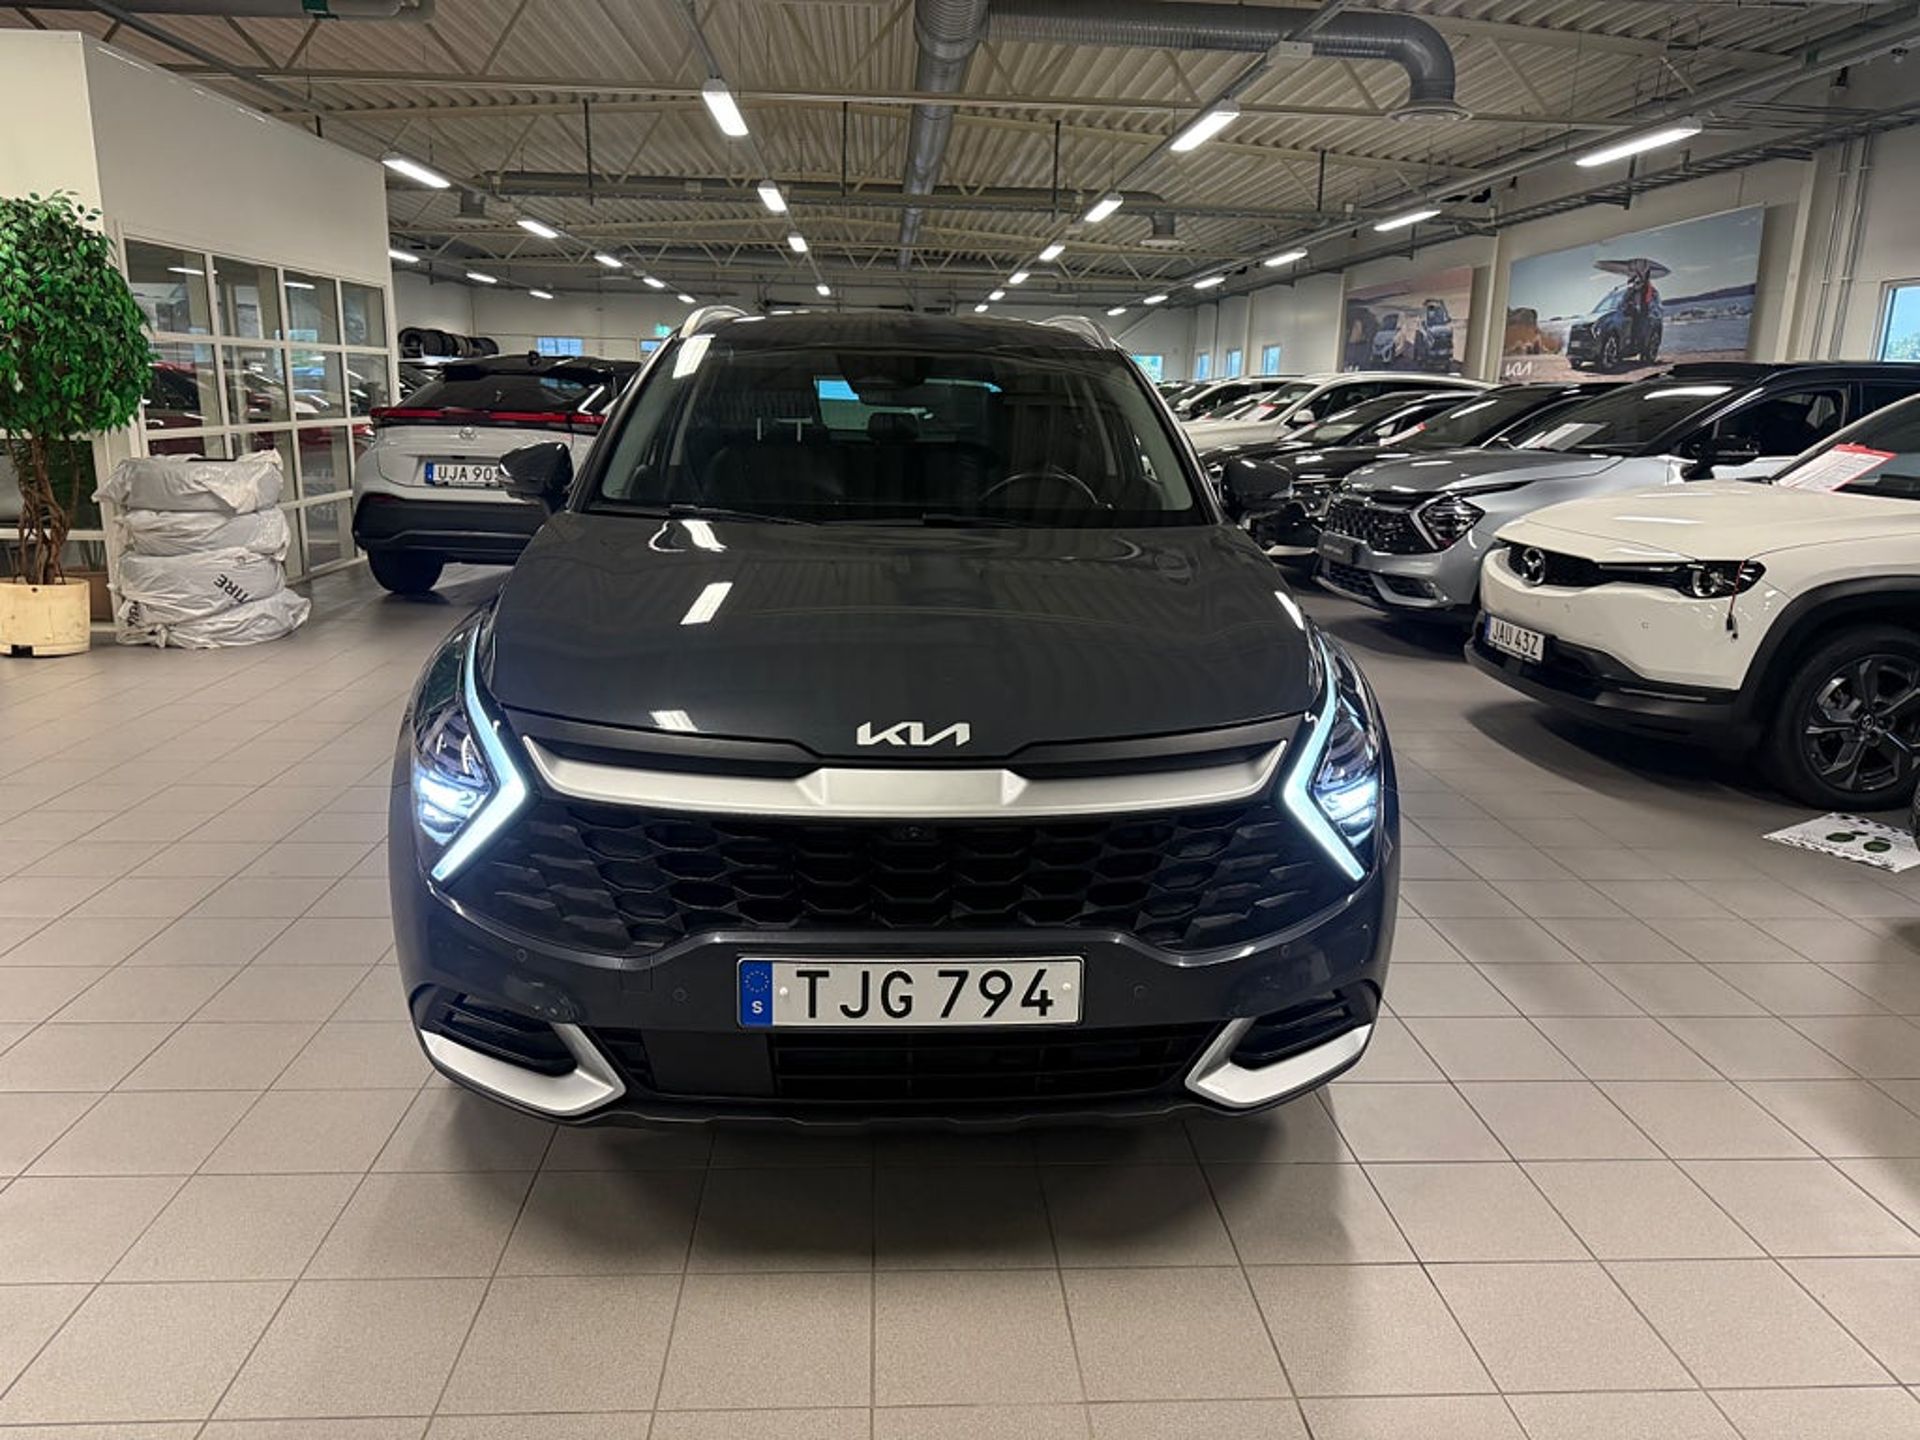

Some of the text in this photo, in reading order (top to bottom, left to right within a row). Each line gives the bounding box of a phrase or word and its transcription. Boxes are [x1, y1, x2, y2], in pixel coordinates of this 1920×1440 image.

[438, 466, 467, 481] UJA
[213, 573, 249, 603] TIRE
[857, 721, 970, 747] KIA
[796, 968, 1054, 1019] TJG 794
[751, 1000, 764, 1014] S
